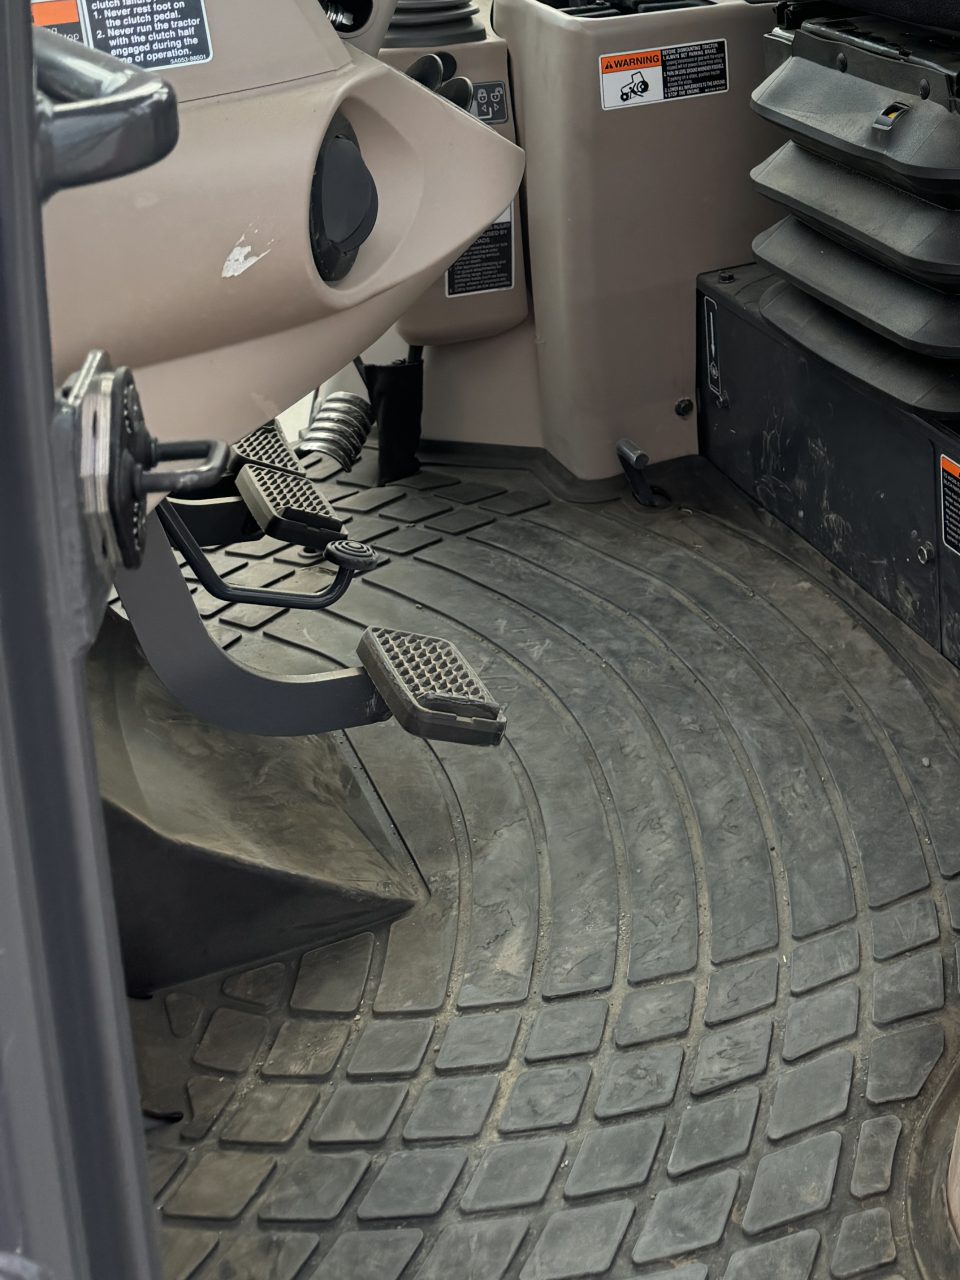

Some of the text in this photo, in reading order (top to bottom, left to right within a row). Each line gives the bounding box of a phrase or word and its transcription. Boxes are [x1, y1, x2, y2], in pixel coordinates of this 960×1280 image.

[91, 0, 120, 9] clutch
[104, 9, 131, 18] Never
[133, 4, 151, 14] rest
[153, 2, 171, 11] foot
[173, 1, 185, 9] on
[106, 10, 181, 27] the clutch pedal.
[96, 18, 201, 39] 2. Never run the tractor
[109, 27, 195, 46] with the clutch half
[111, 36, 199, 56] engaged during the
[135, 54, 144, 62] of
[146, 48, 192, 62] operation.
[613, 54, 660, 69] WARNING
